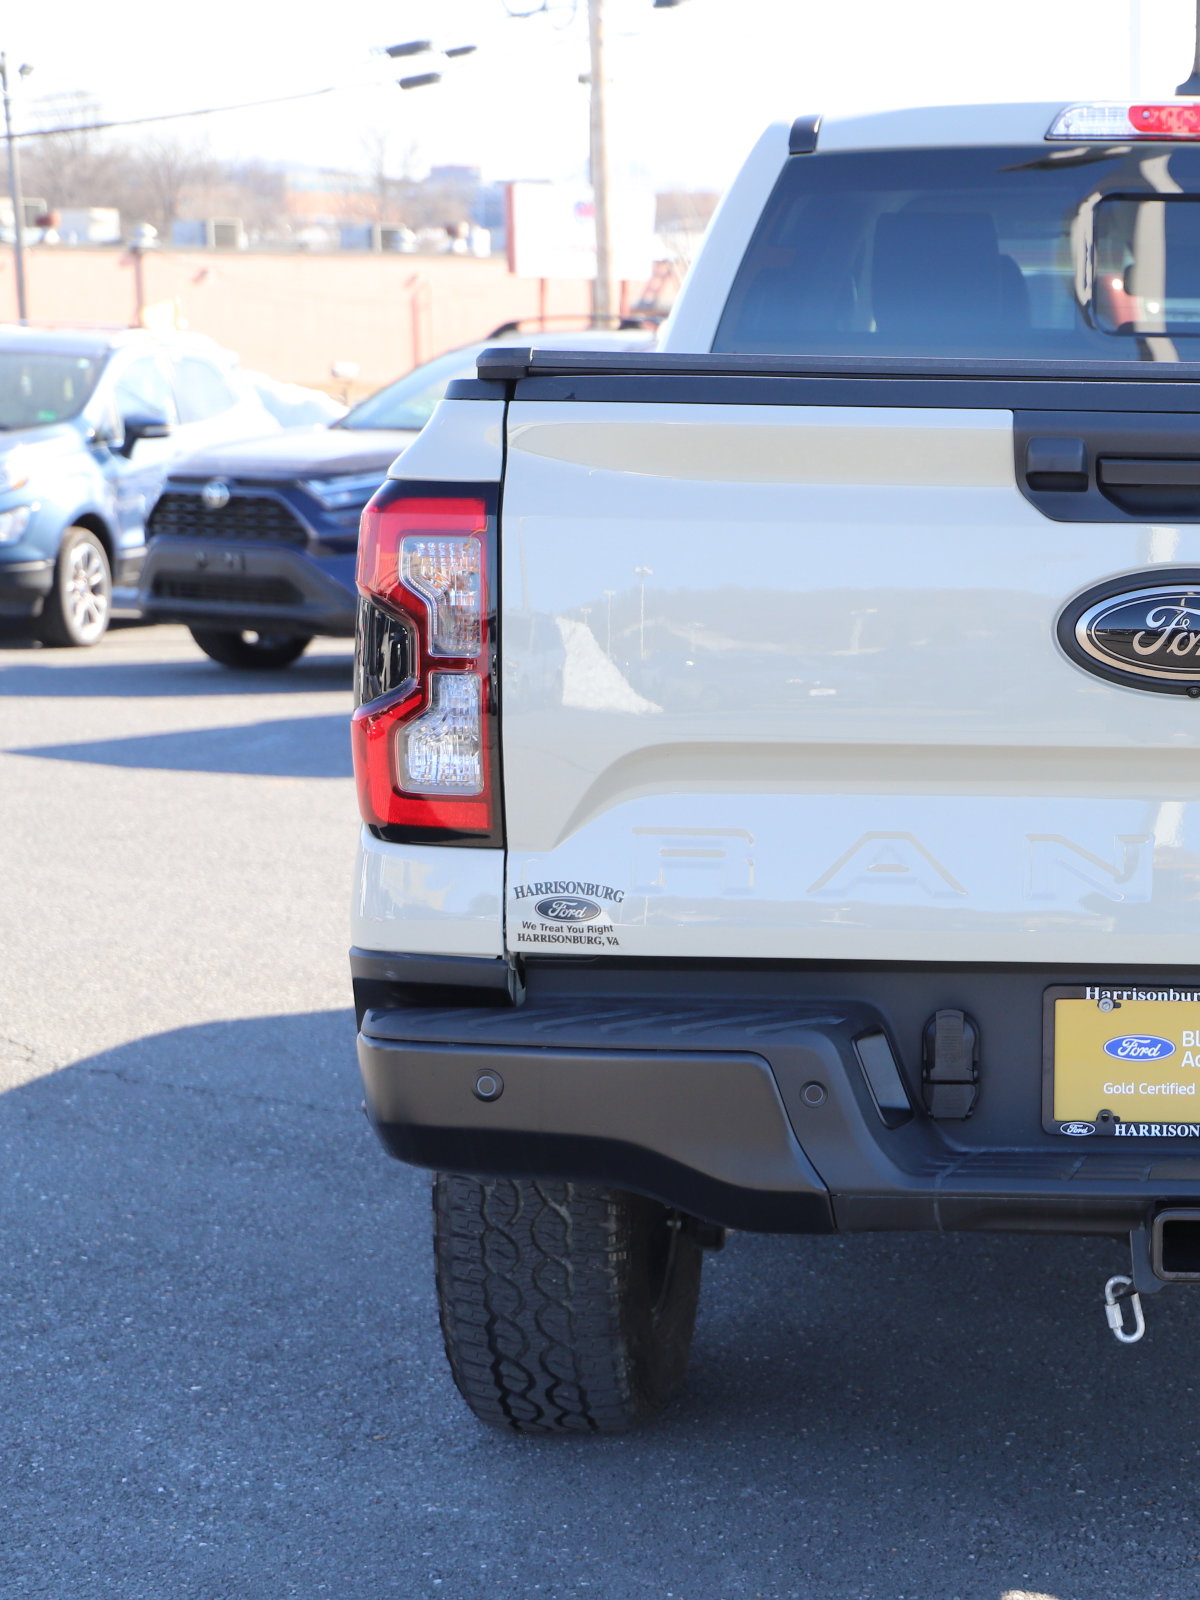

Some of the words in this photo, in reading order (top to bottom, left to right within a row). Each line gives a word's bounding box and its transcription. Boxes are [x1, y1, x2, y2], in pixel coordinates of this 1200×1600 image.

[513, 880, 625, 903] HARRISONBURG
[548, 900, 587, 918] Ford
[522, 921, 537, 930] We
[540, 923, 564, 933] Treat
[567, 924, 585, 934] You
[588, 925, 614, 936] Right
[517, 933, 605, 946] HARRISONBURG,
[607, 937, 620, 946] VA
[1117, 1039, 1161, 1057] Ford
[1103, 1082, 1135, 1095] Gold
[1139, 1082, 1196, 1096] Certified
[1067, 1124, 1089, 1134] Ford
